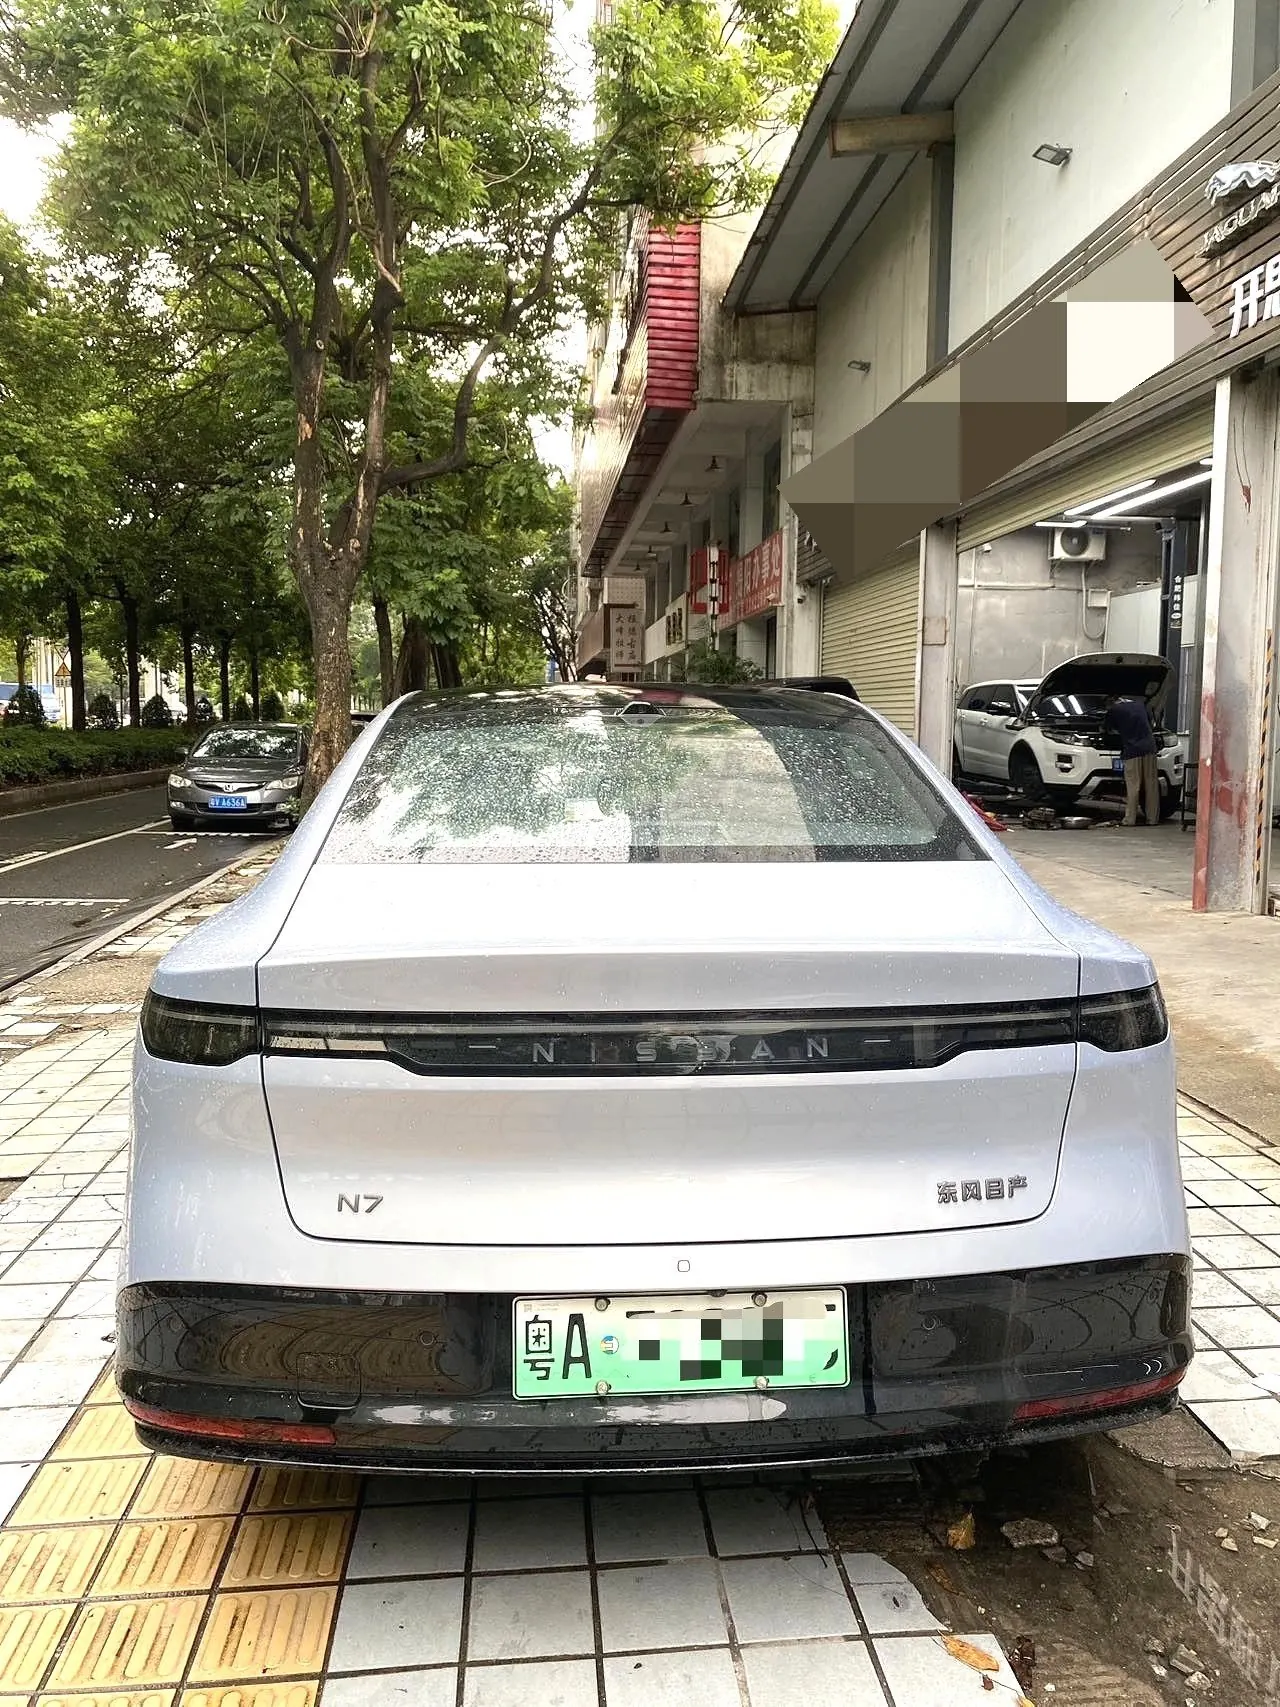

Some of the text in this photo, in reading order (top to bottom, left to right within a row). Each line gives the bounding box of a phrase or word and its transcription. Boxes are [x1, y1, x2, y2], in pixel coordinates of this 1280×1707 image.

[532, 1037, 829, 1063] NISSAN
[937, 1175, 1028, 1203] 东风日产
[337, 1194, 384, 1213] N7
